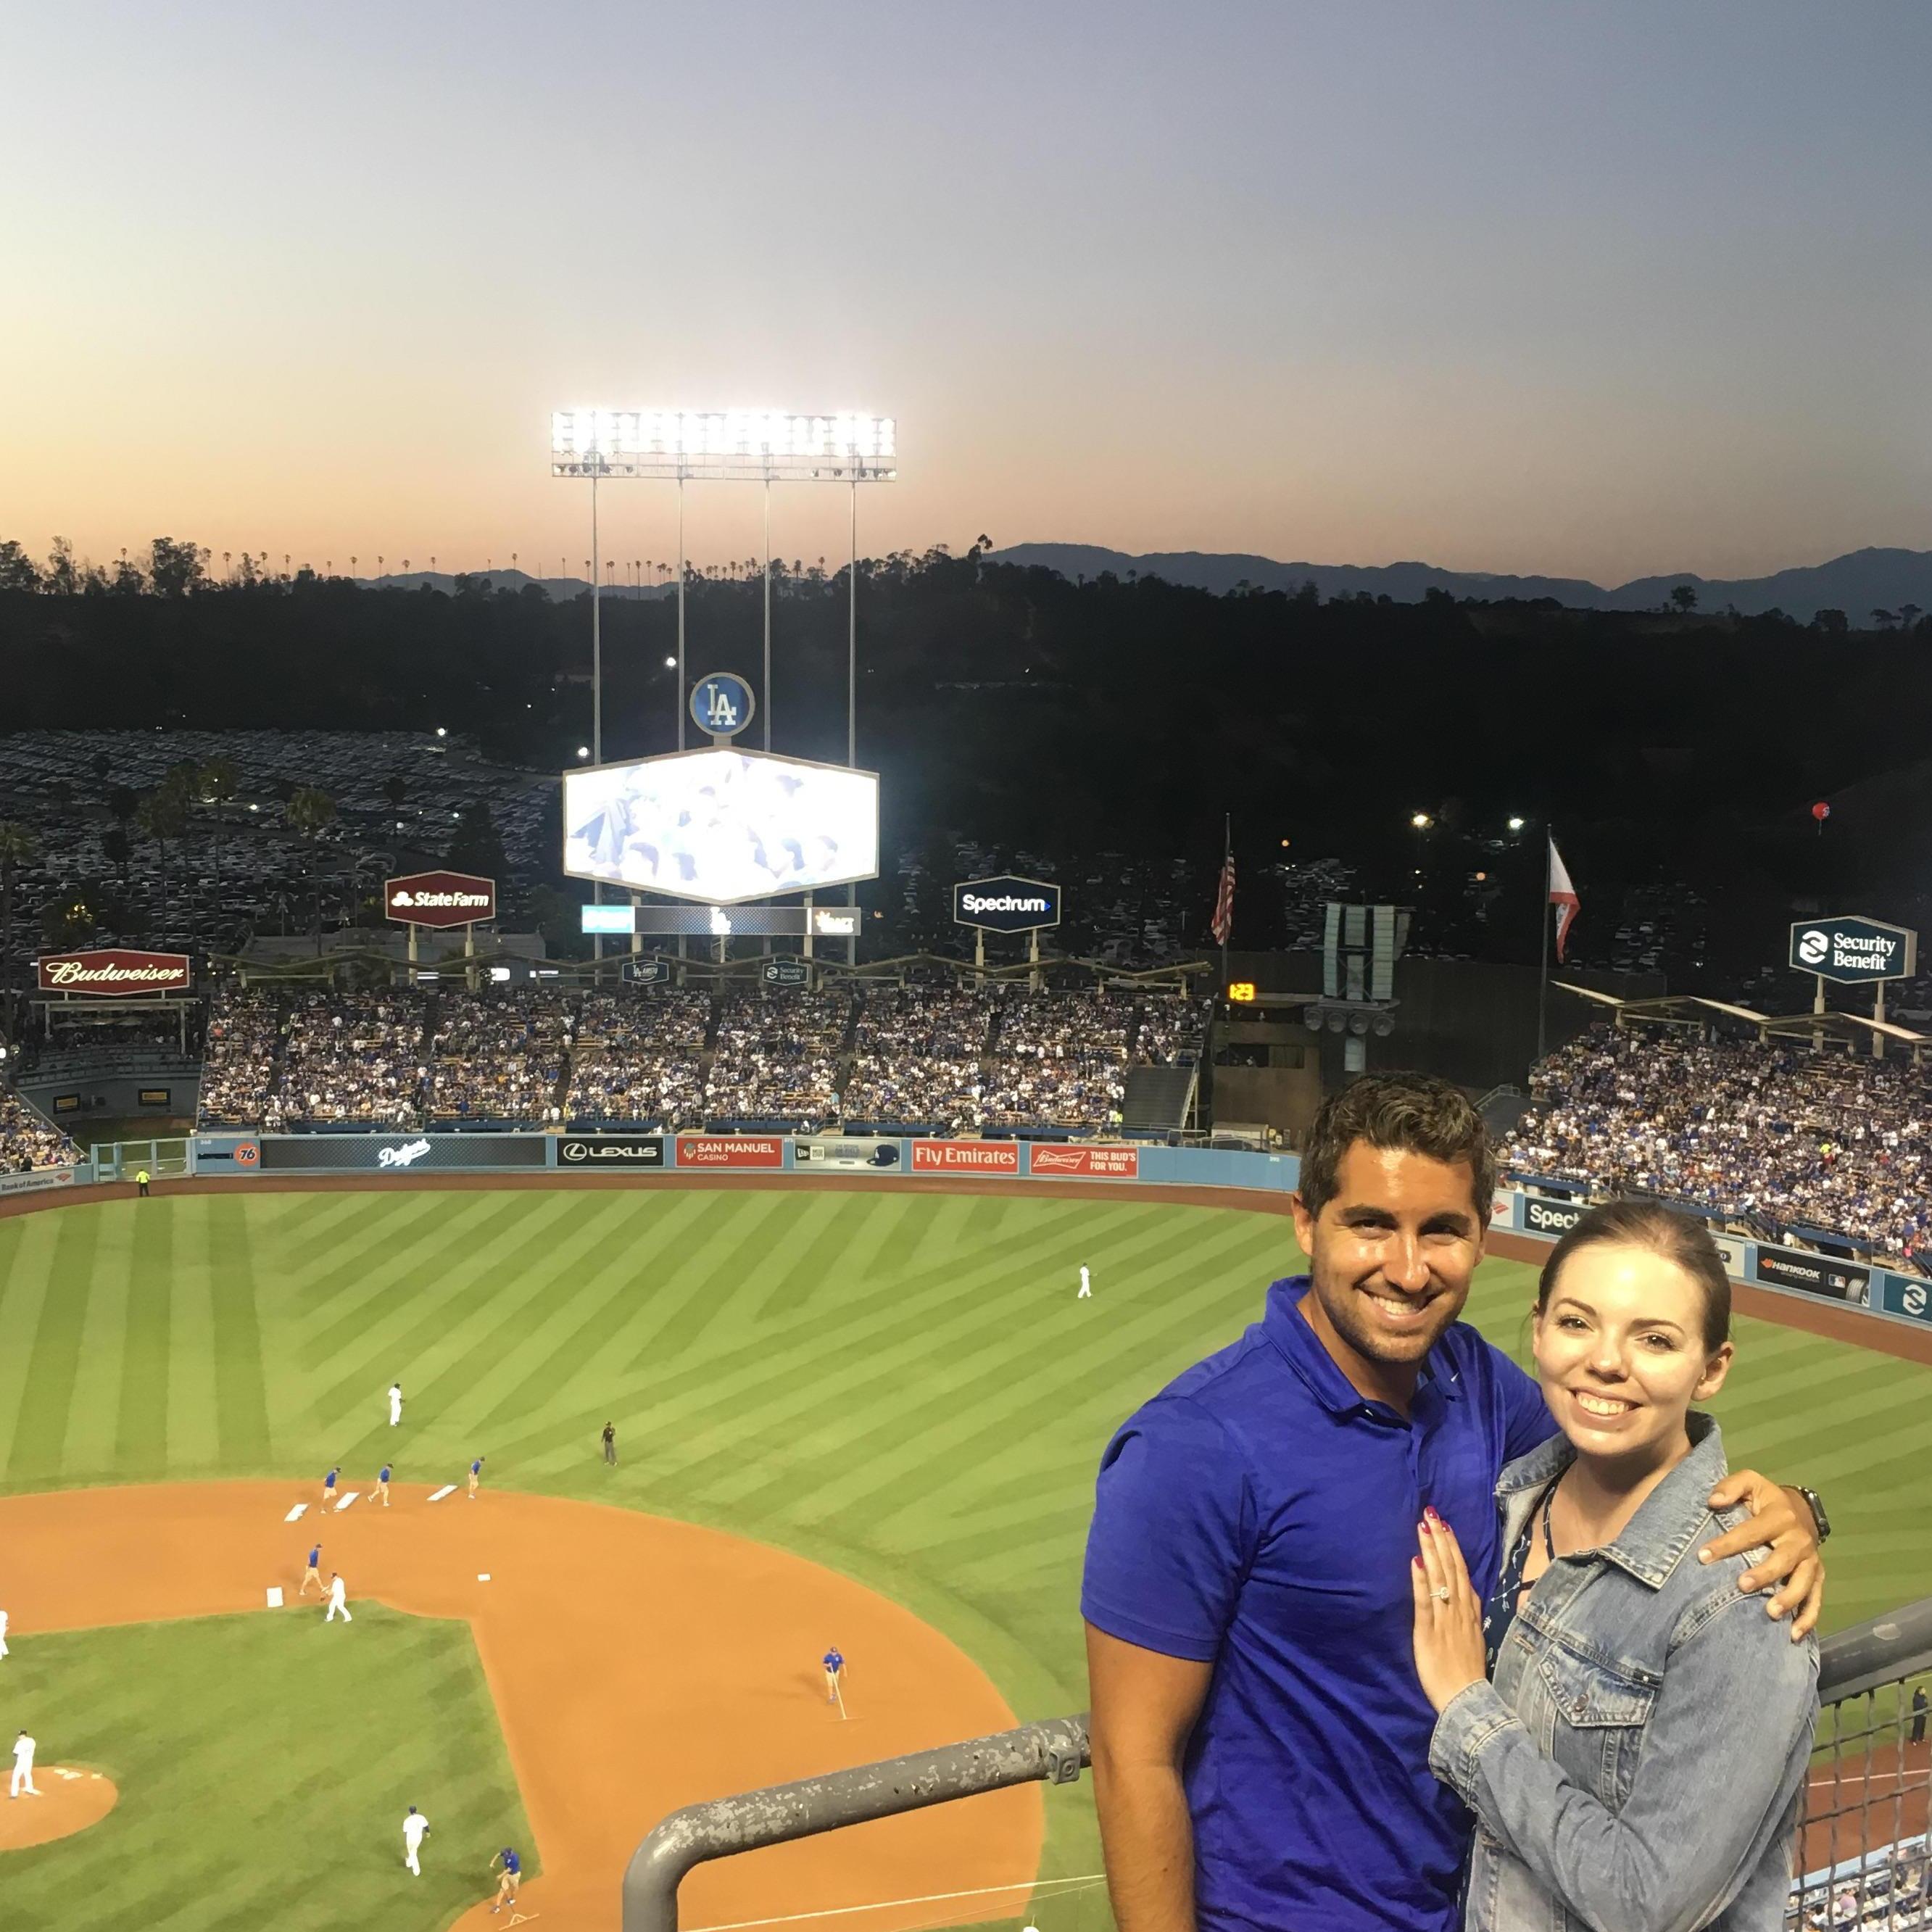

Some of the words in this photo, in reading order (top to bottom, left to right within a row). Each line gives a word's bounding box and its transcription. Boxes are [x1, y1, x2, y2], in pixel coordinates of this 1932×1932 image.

[708, 684, 737, 725] LA
[963, 894, 1045, 914] Spectrum
[1833, 933, 1896, 957] Security
[1833, 950, 1886, 971] Benefit
[46, 961, 184, 984] Budweiser
[779, 966, 804, 977] Security
[239, 1147, 256, 1161] 76
[589, 1147, 658, 1157] LEXUS
[697, 1143, 722, 1153] SAN
[726, 1143, 775, 1153] MANUEL
[916, 1148, 942, 1166] Fly
[945, 1148, 1016, 1165] Emirates
[1090, 1151, 1109, 1161] THIS
[1111, 1152, 1136, 1161] BUD'S
[1090, 1161, 1106, 1170] FOR
[1107, 1162, 1127, 1172] YOU.
[26, 1178, 54, 1187] America
